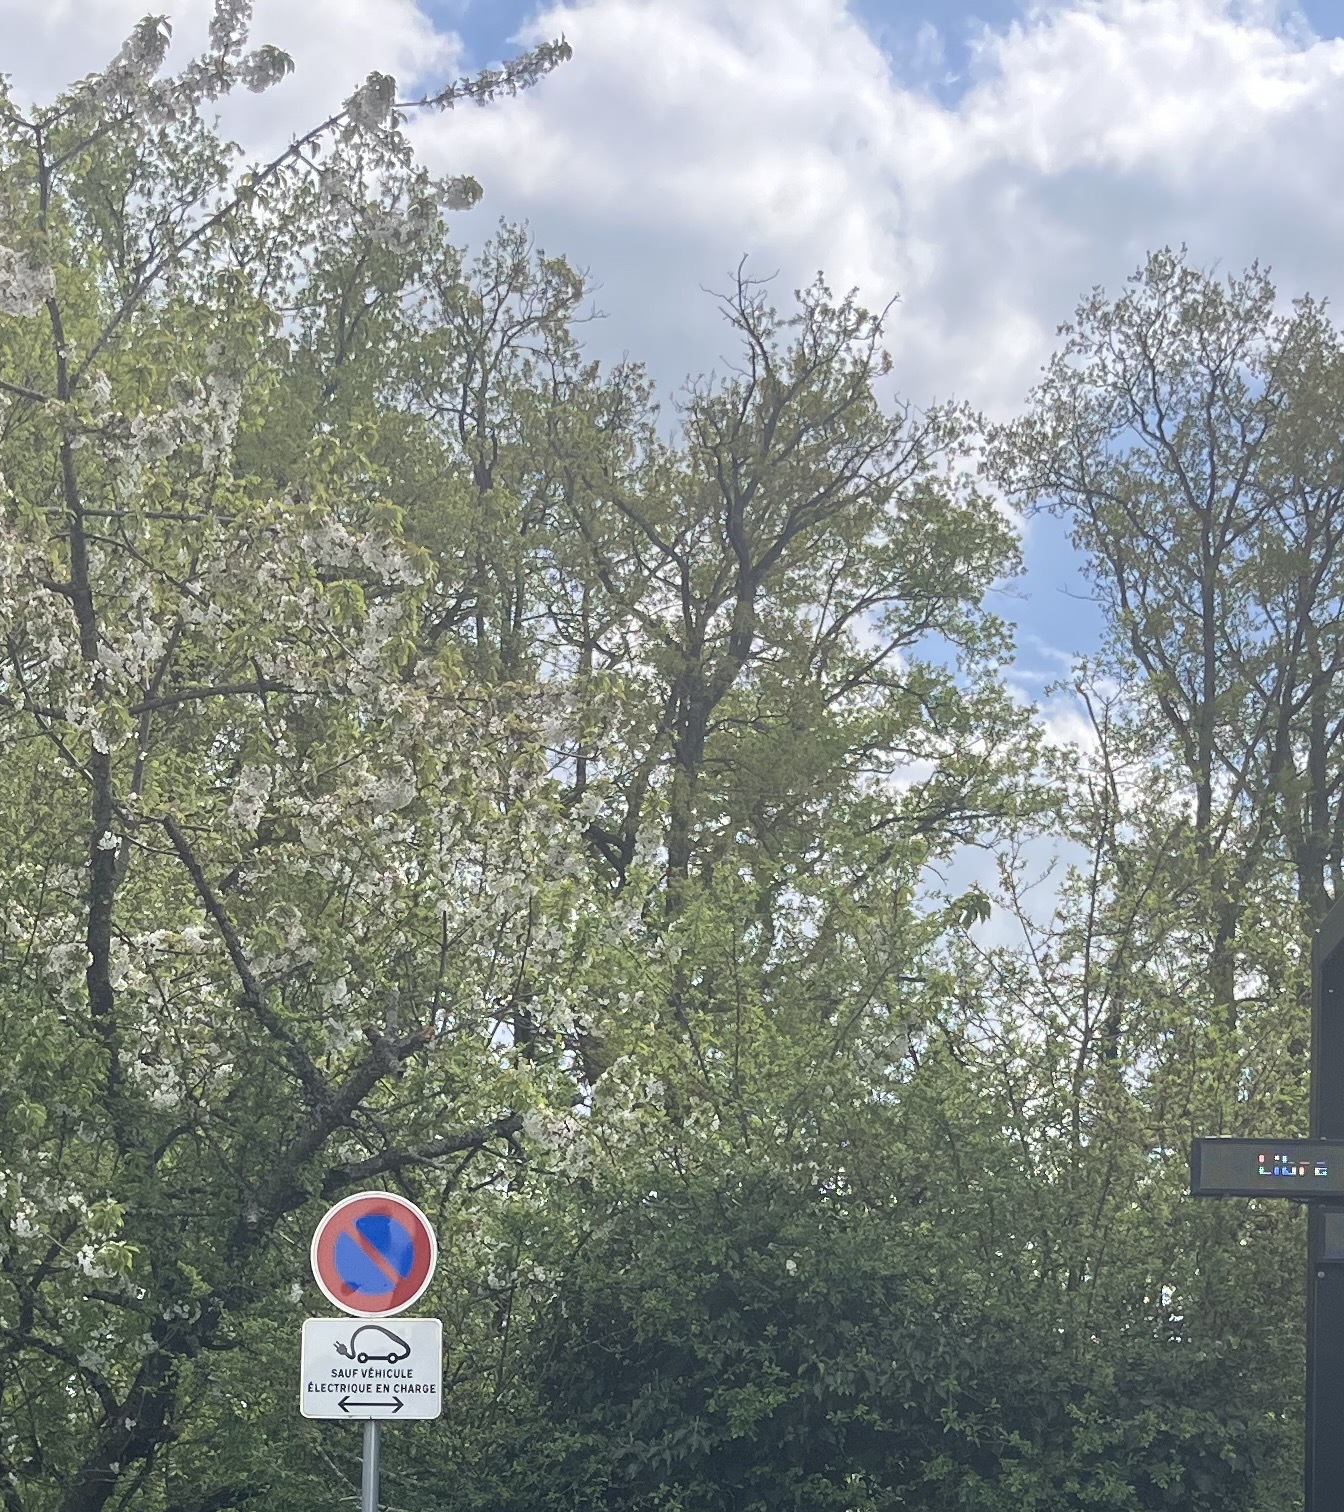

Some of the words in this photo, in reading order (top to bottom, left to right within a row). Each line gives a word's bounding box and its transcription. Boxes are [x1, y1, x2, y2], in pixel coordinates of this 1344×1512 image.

[331, 1368, 359, 1379] SAUF
[361, 1367, 413, 1379] VÉHICULE
[307, 1381, 372, 1393] ÉLECTRIQUE
[376, 1383, 390, 1393] EN
[393, 1383, 436, 1393] CHARGE
